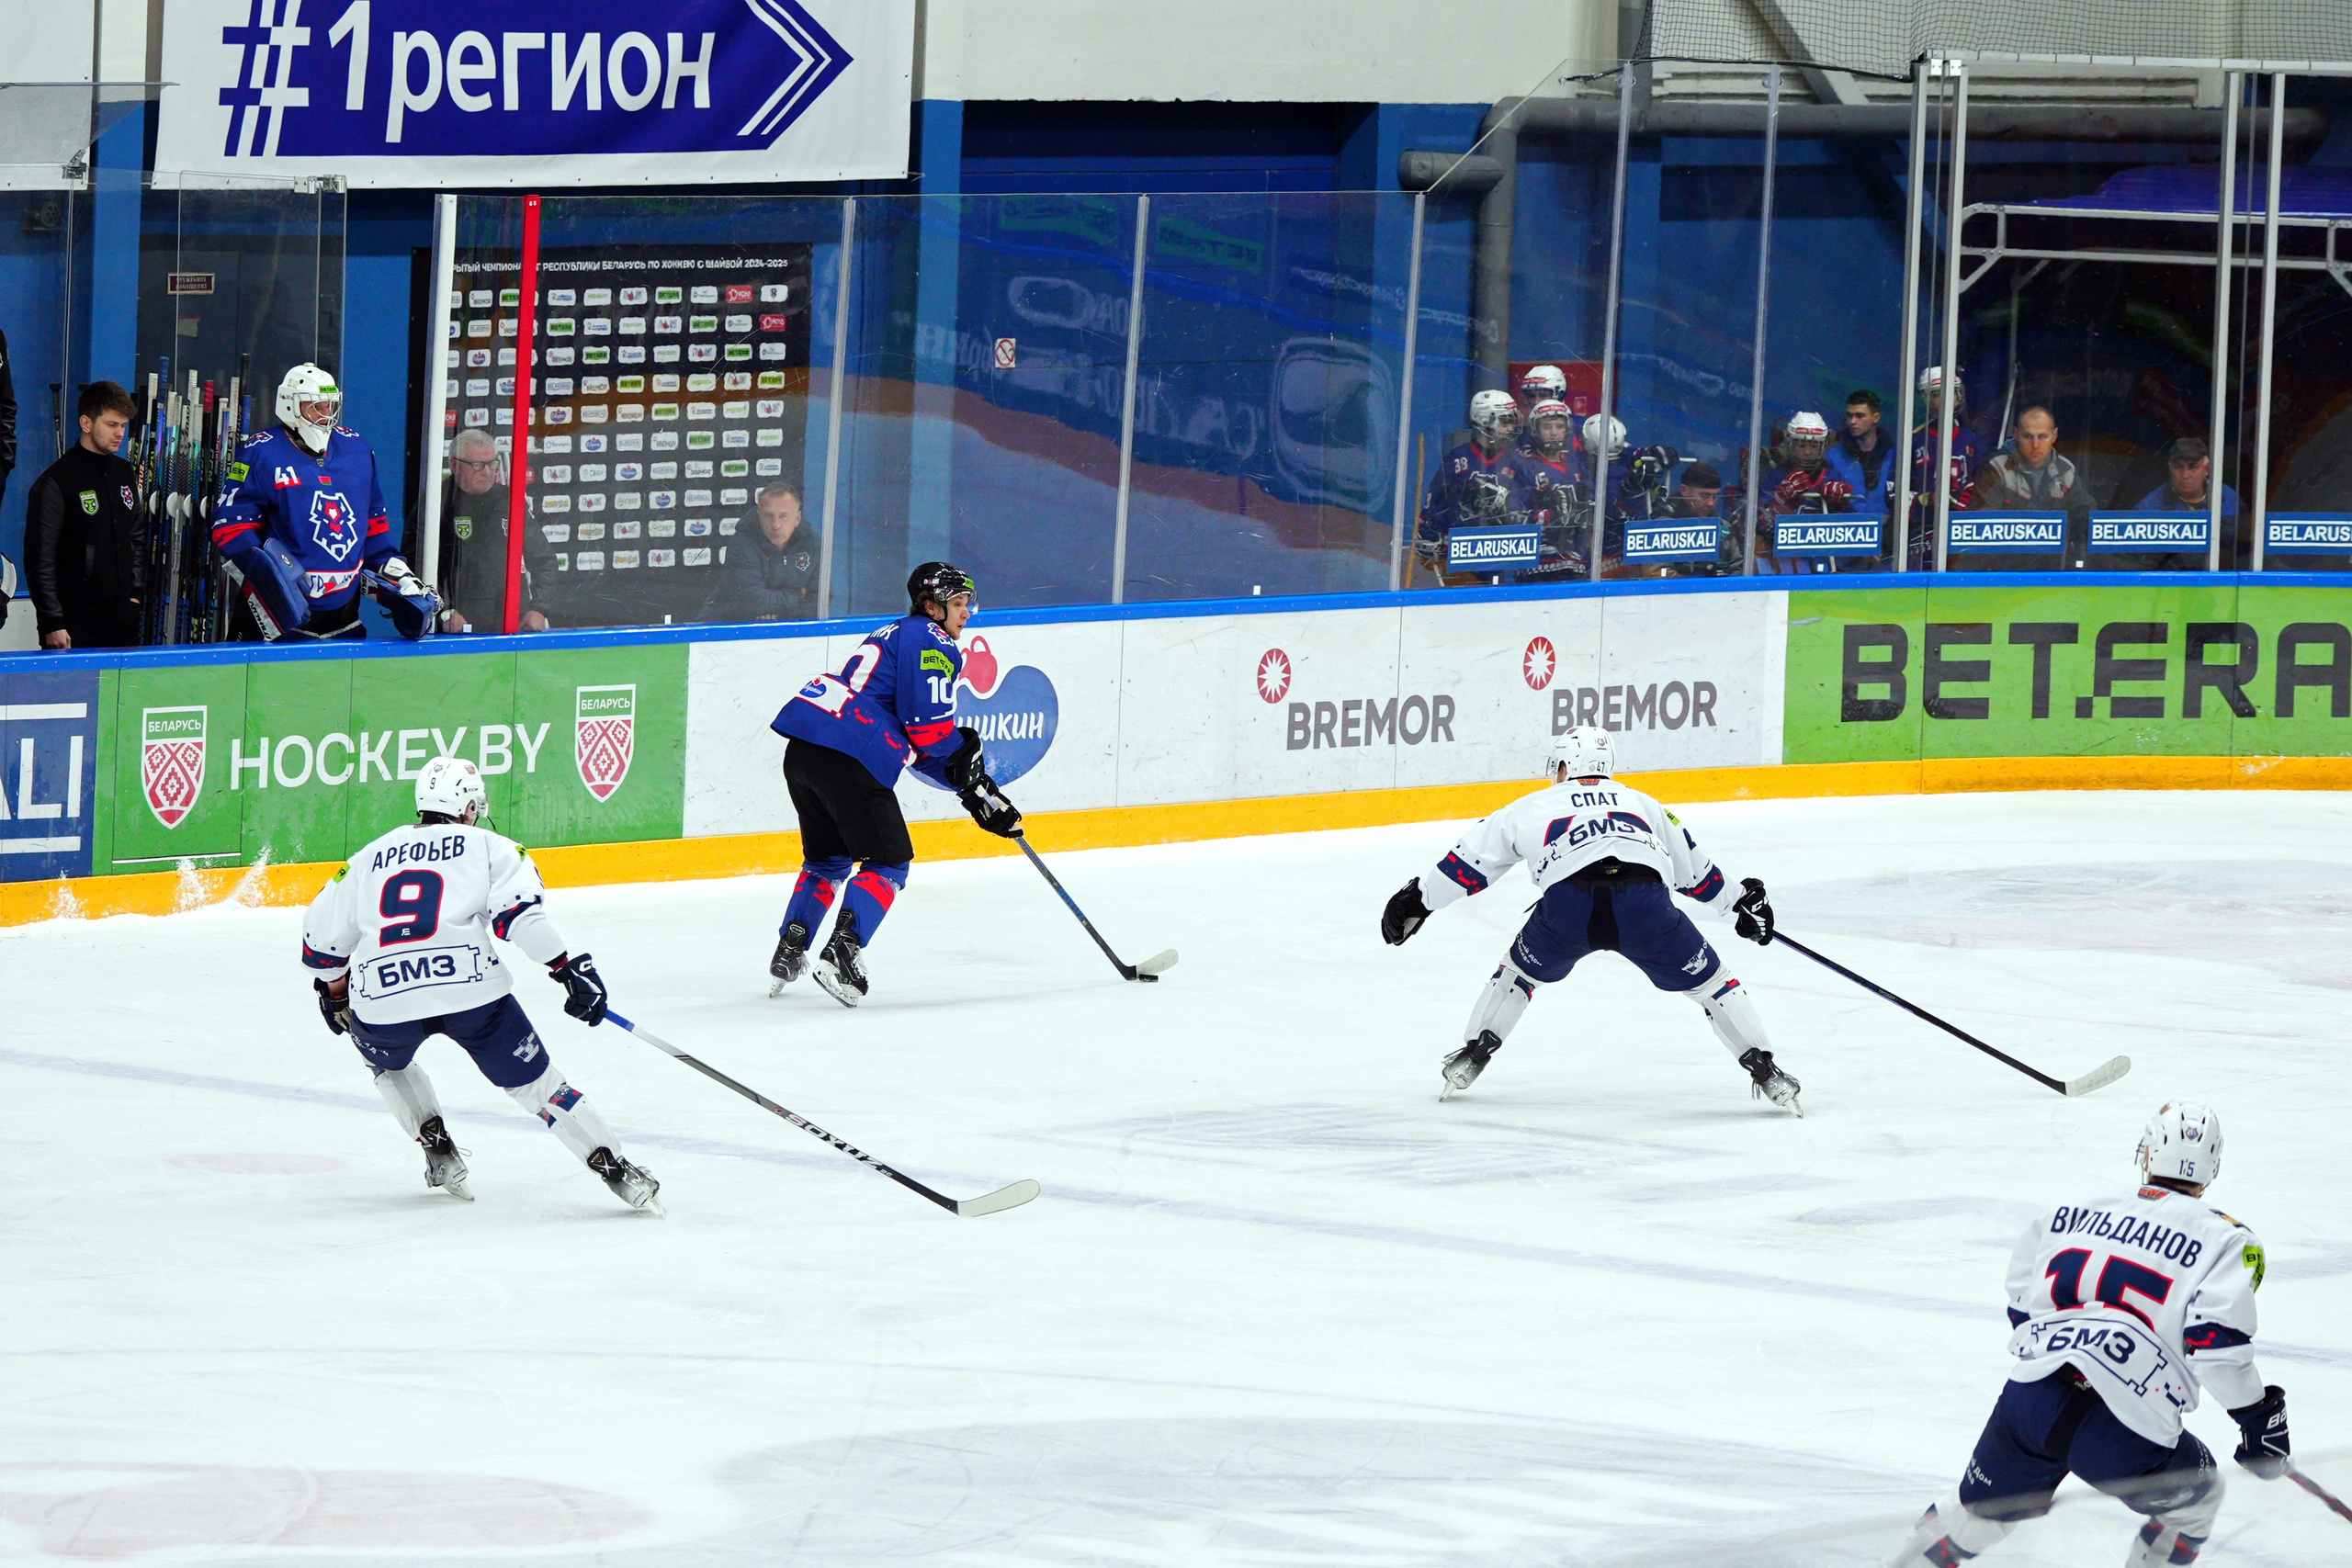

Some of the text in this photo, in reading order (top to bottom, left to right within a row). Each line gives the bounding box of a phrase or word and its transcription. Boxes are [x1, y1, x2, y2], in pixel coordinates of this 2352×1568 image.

[543, 261, 601, 272] РЕСПУБЛИКИ
[602, 259, 646, 271] БЕЛАРУСЬ
[648, 260, 661, 270] ПО
[696, 260, 705, 269] С
[706, 257, 743, 269] ШАЙБОЙ
[275, 466, 299, 485] 41
[1626, 530, 1716, 550] BELARUSKALI
[1777, 526, 1878, 546] BELARUSKALI
[1951, 524, 2062, 540] BELARUSKALI
[2091, 524, 2207, 540] BELARUSKALI
[1450, 538, 1538, 558] BELARUSKALI
[581, 696, 632, 711] БЕЛАРУСЬ
[1551, 681, 1718, 737] BREMOR
[148, 719, 202, 733] БЕЛАРУСЬ
[1286, 694, 1456, 751] BREMOR
[0, 735, 84, 820] LI
[429, 777, 436, 790] 9
[1570, 792, 1619, 808] СПАТ
[371, 834, 466, 873] АРЕФЬЕВ
[379, 869, 445, 947] 9
[377, 954, 457, 988] БМЗ
[2178, 1159, 2196, 1178] 15
[2050, 1205, 2203, 1269] ВИЛЬДАНОВ
[2044, 1247, 2175, 1334] 15
[2046, 1325, 2136, 1364] БМЗ
